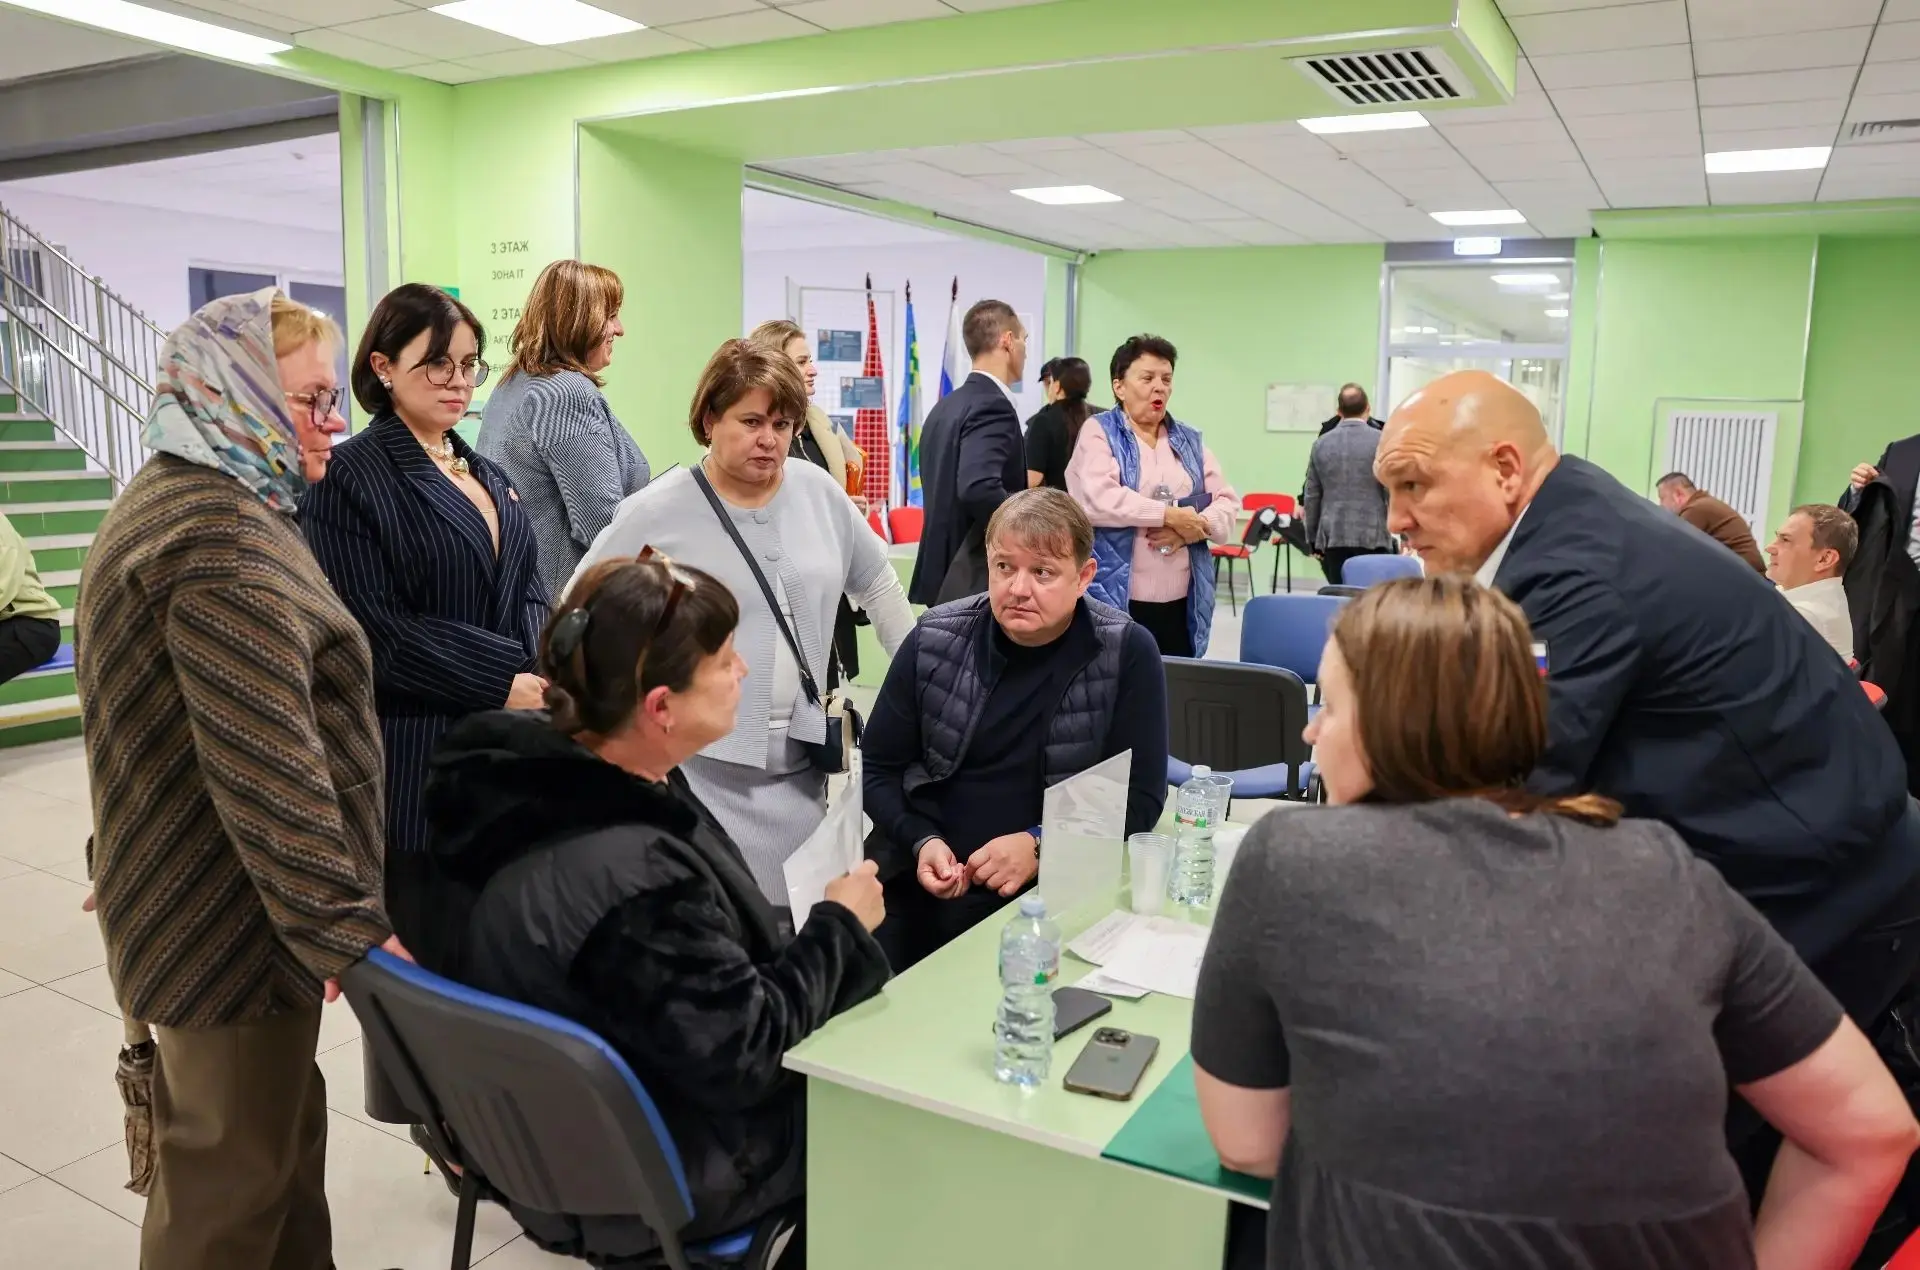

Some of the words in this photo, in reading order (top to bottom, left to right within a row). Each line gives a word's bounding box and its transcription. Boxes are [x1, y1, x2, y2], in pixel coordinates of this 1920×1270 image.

[491, 242, 497, 254] 3
[500, 240, 529, 253] ЭТАЖ
[492, 269, 515, 280] ЗОНА
[492, 308, 498, 320] 2
[501, 307, 523, 320] ЭТА
